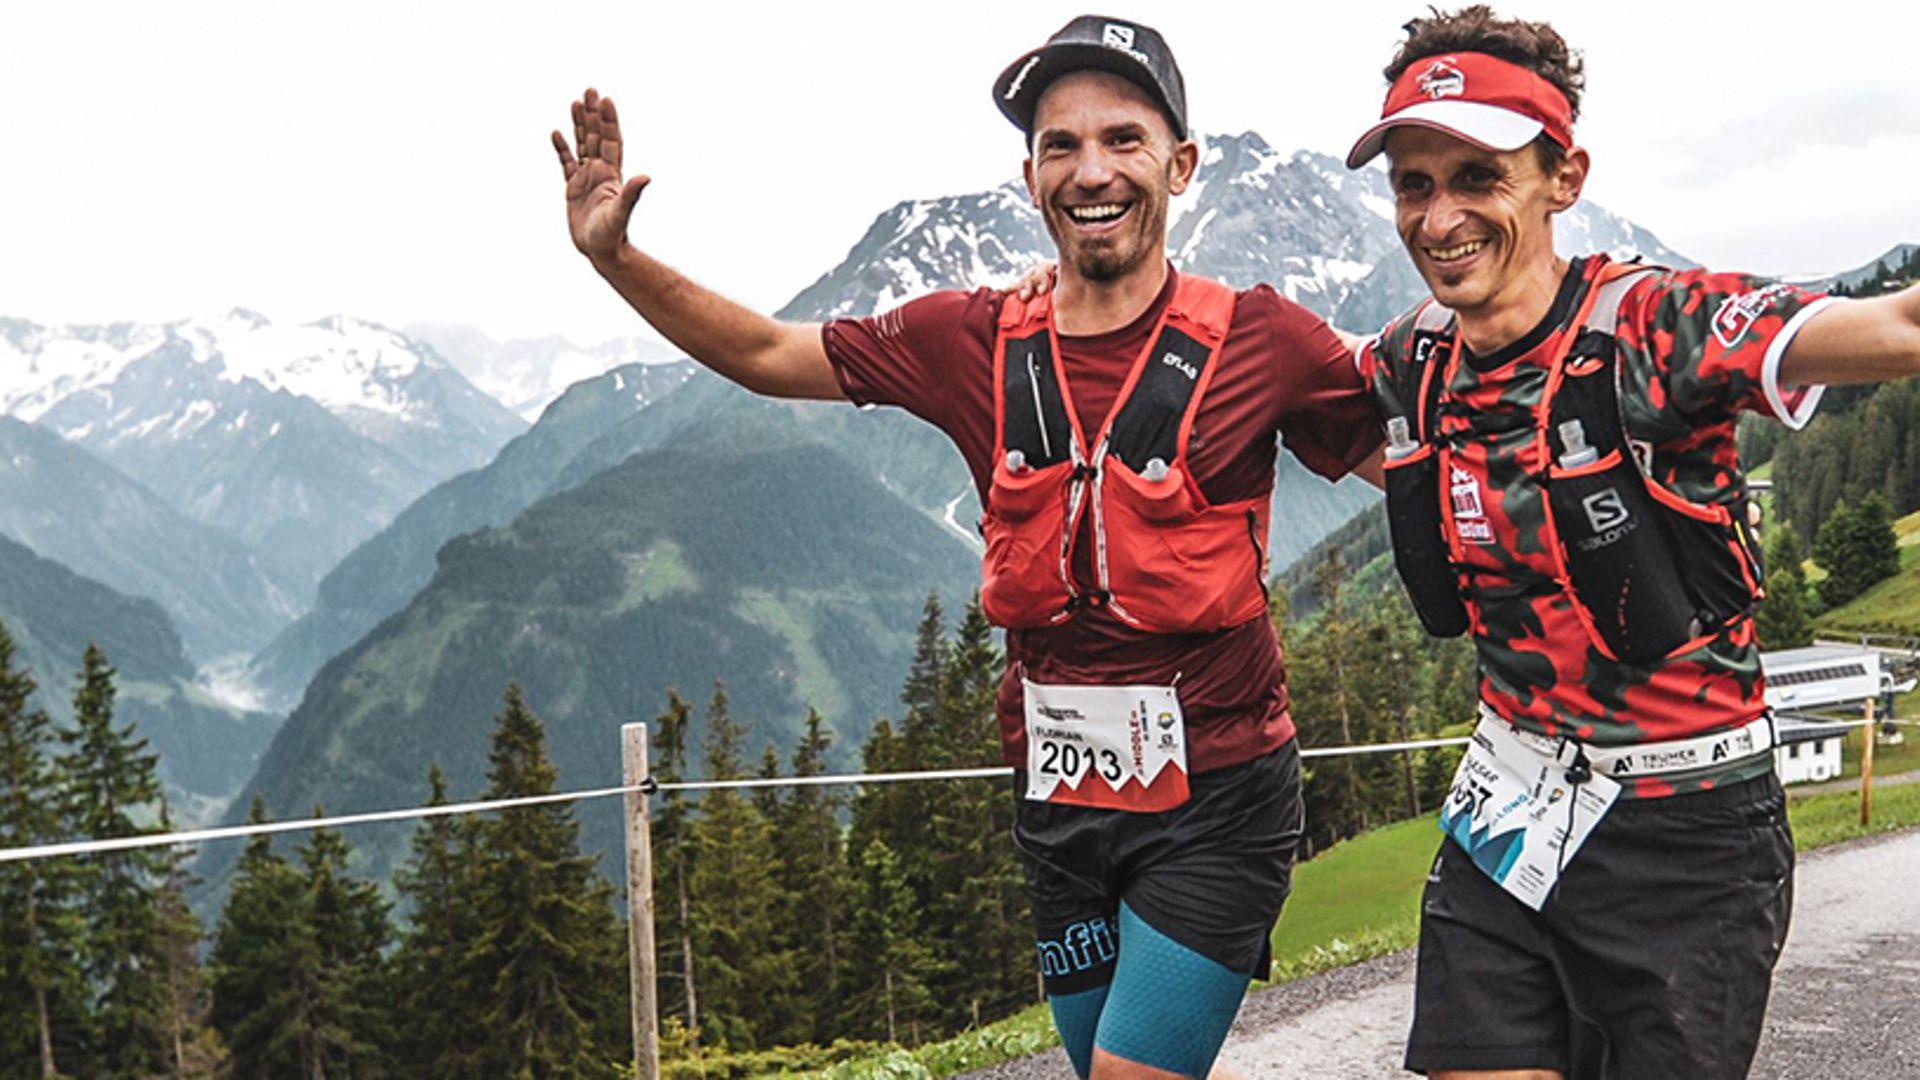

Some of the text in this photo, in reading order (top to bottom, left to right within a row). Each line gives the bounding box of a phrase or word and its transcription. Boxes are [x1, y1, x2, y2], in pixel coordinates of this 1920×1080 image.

[1036, 726, 1083, 742] FLORIAN
[1041, 741, 1122, 782] 2013
[1038, 918, 1116, 976] nfi
